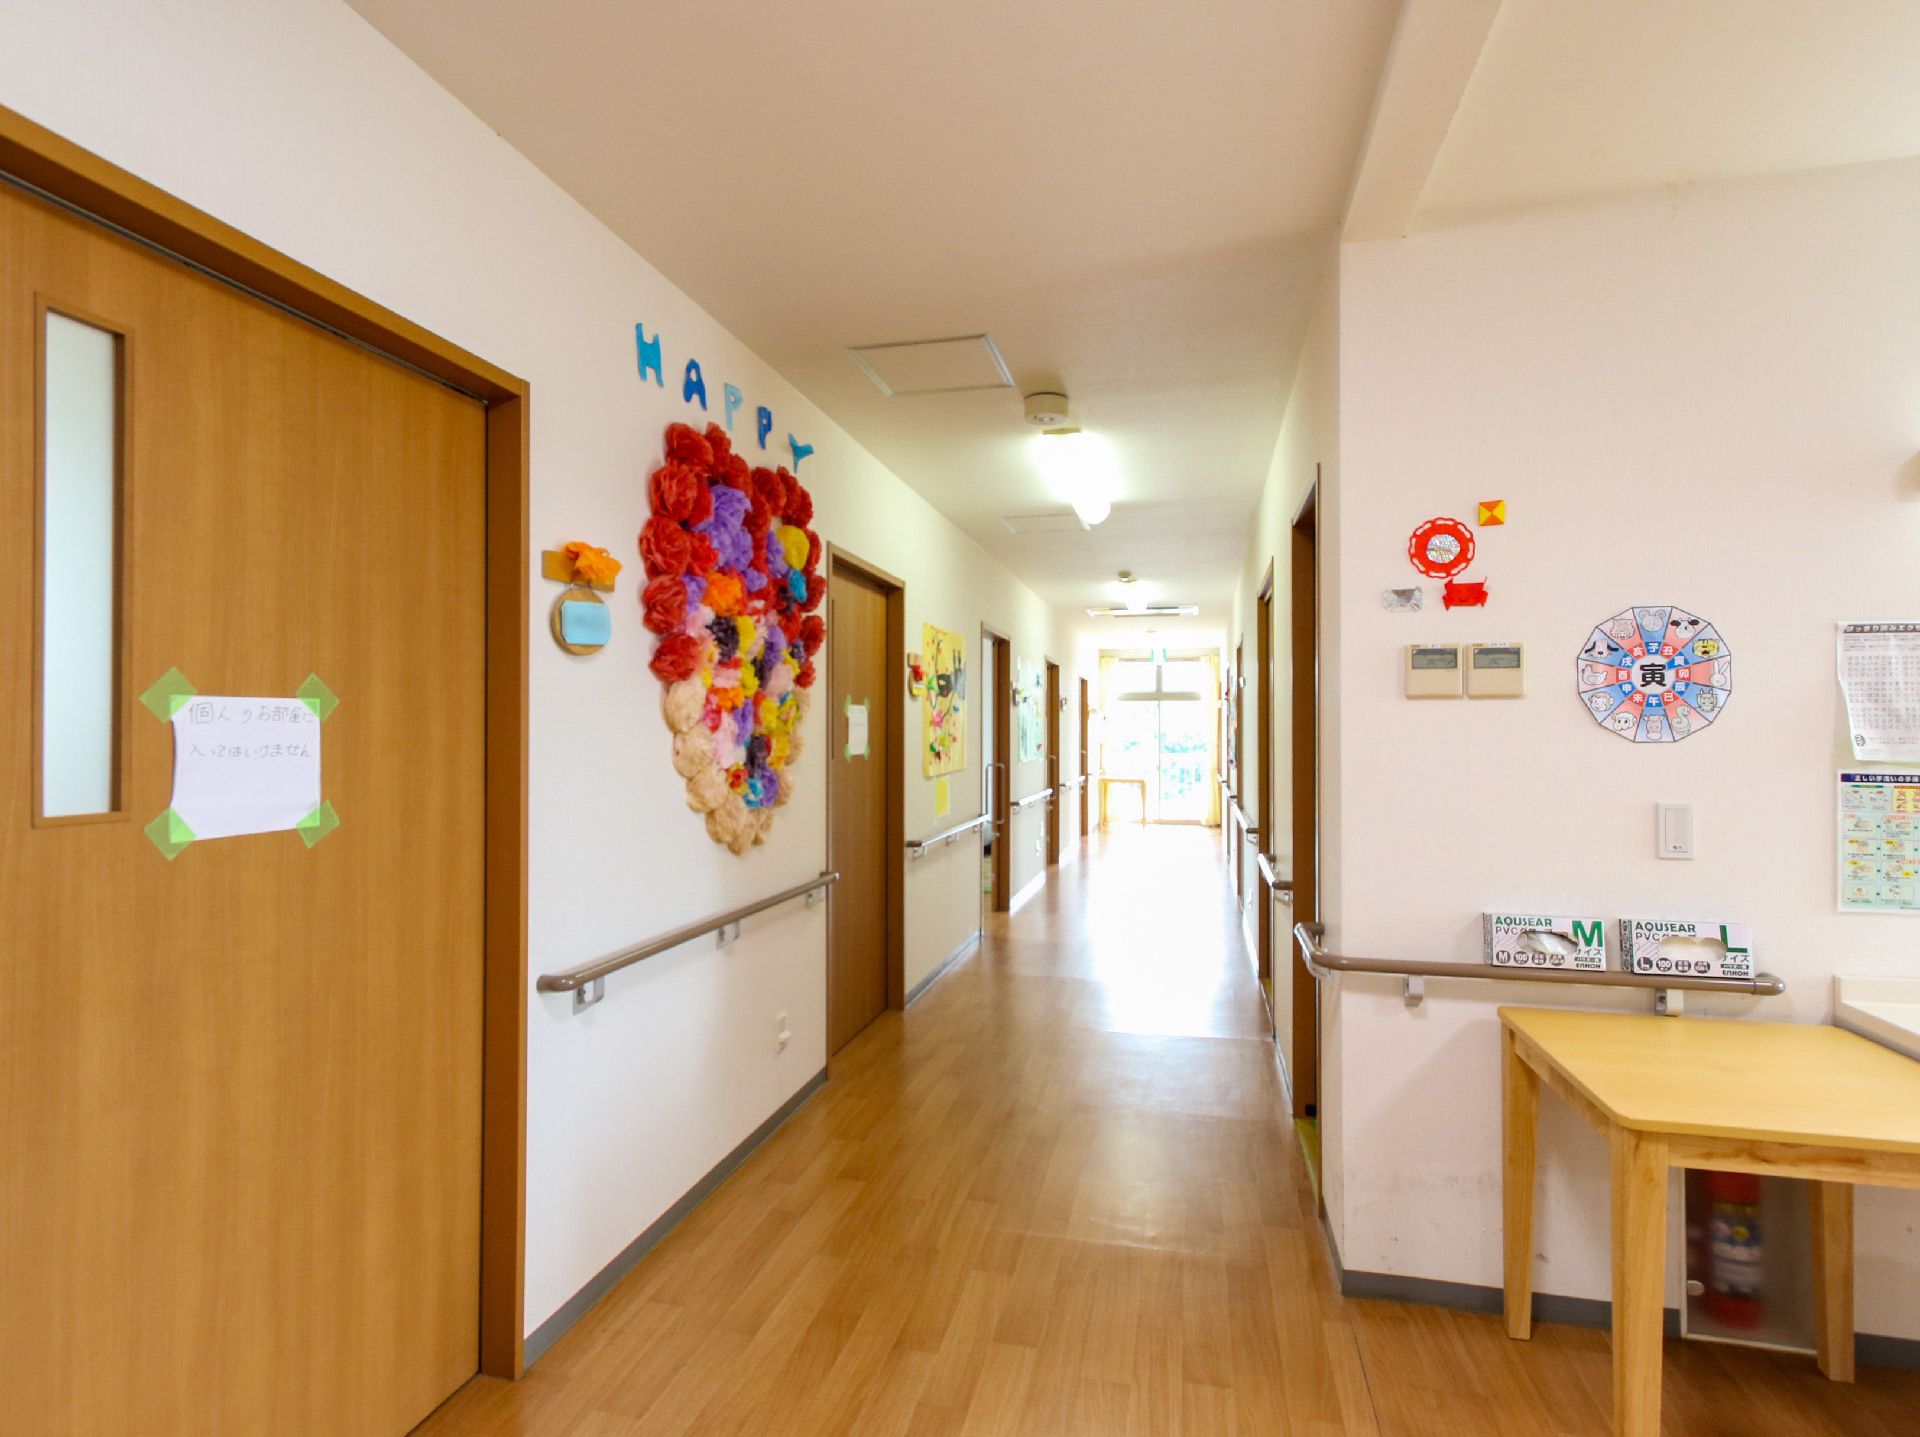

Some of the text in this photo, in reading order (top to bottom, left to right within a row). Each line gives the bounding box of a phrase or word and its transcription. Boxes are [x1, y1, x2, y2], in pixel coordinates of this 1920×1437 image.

[636, 322, 814, 474] HAPPY
[1648, 642, 1659, 653] 子
[1663, 646, 1674, 656] 丑
[1640, 663, 1667, 687] 寅
[1622, 683, 1632, 694] 申
[1633, 693, 1644, 703] 未
[1648, 695, 1660, 706] 午
[1571, 920, 1604, 948] M
[1719, 925, 1748, 953] L
[1656, 959, 1671, 968] 100
